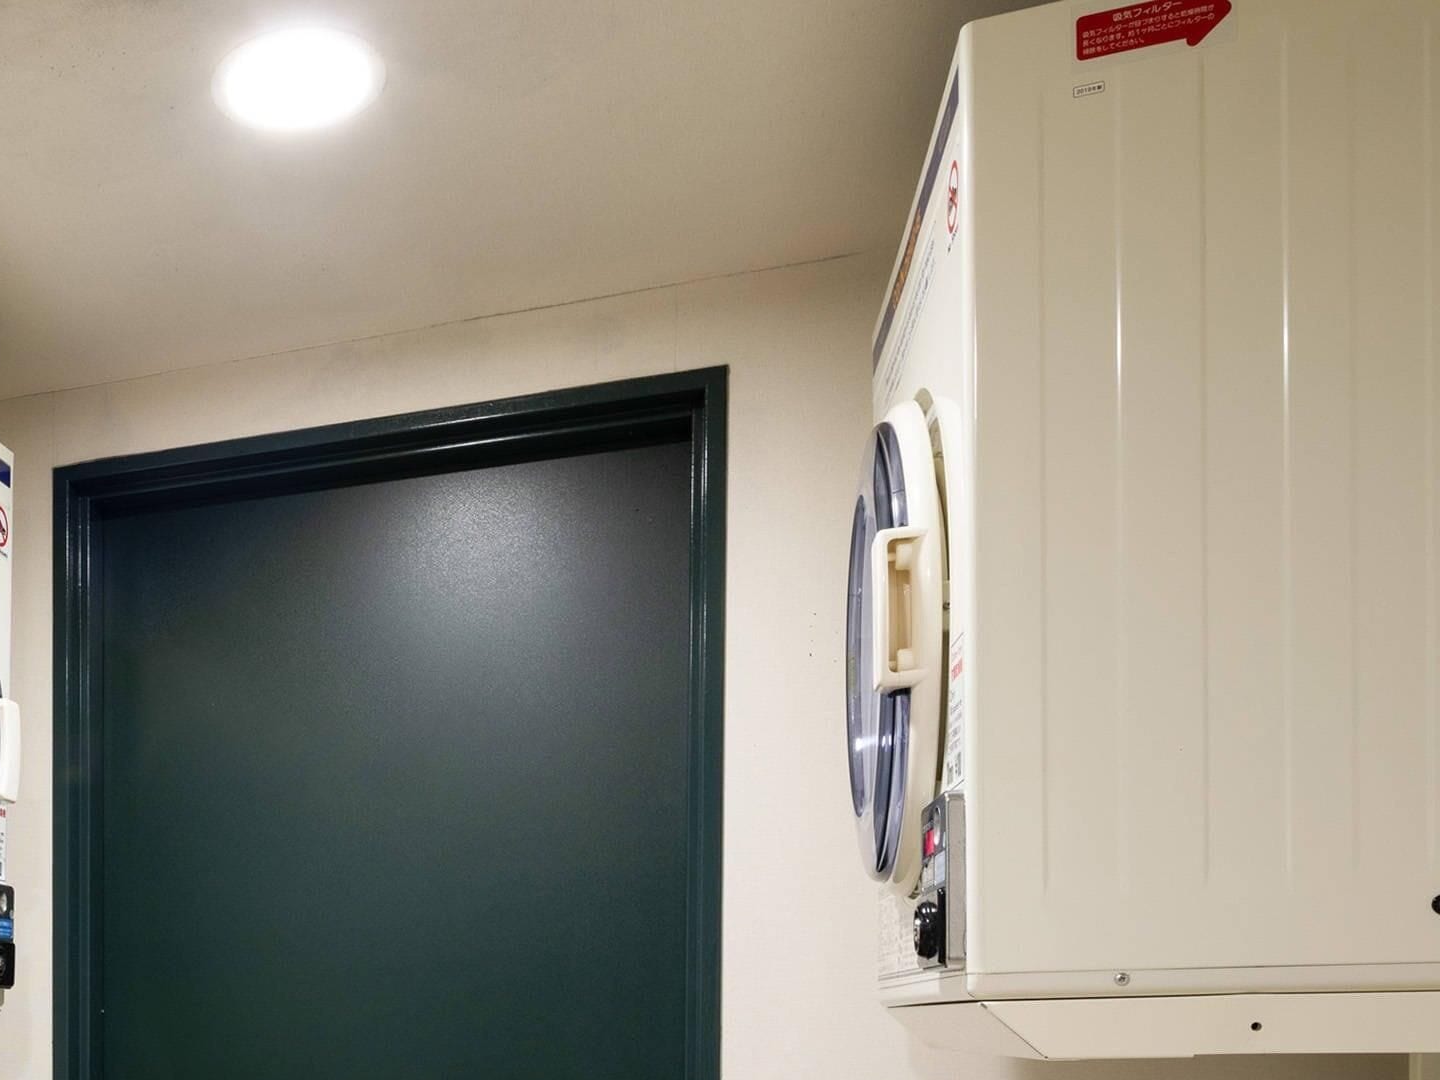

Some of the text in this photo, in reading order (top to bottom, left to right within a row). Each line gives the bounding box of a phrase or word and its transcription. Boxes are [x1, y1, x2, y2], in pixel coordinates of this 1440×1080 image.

[1112, 1, 1182, 22] 吸気フィルター
